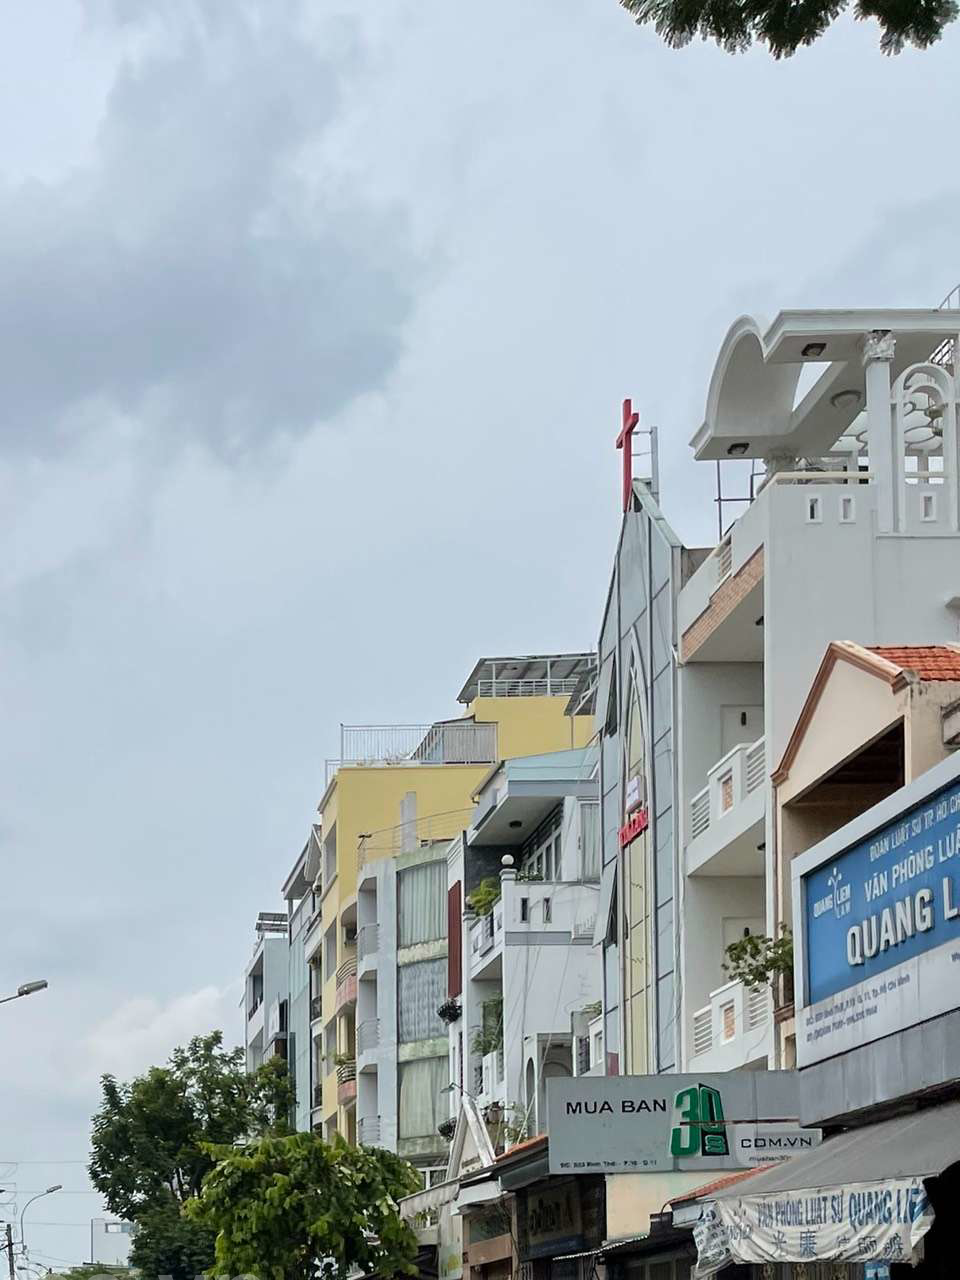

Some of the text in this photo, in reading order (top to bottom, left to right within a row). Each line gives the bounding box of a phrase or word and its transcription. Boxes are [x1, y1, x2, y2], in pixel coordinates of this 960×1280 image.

[892, 844, 934, 888] PHÒNG
[847, 888, 933, 966] QUANG
[566, 1099, 667, 1114] MUA BAN
[848, 1190, 893, 1232] QUANG
